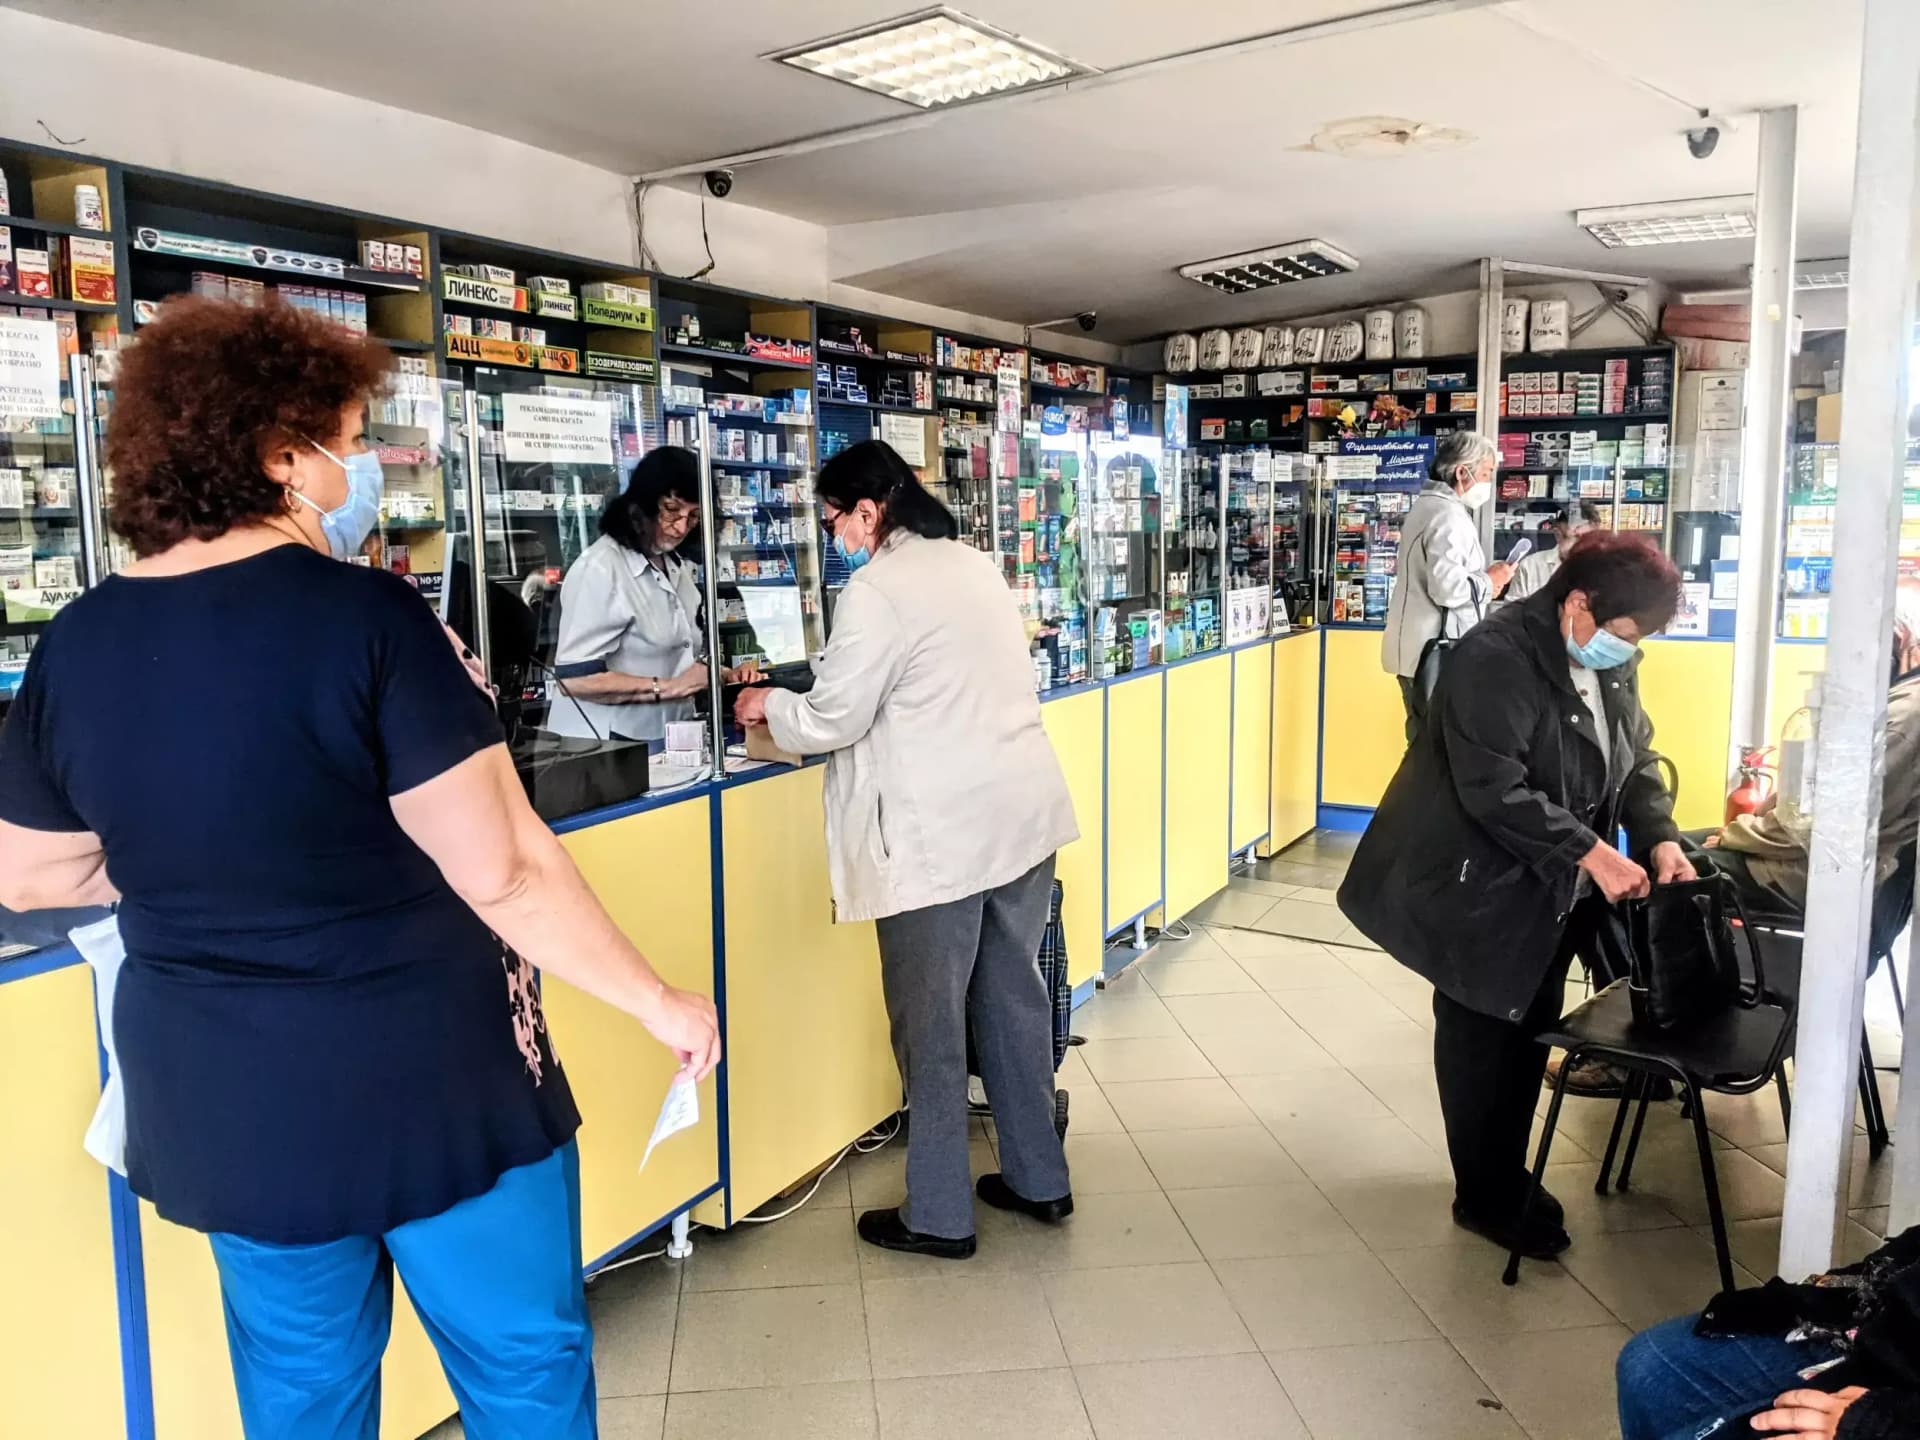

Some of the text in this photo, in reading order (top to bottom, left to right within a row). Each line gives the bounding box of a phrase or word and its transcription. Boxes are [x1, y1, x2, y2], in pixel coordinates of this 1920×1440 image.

[448, 280, 498, 303] ЛИНЕКС
[543, 299, 573, 313] ЛИНЕКС
[587, 303, 633, 322] Попедиум
[450, 337, 481, 358] АЦЦ
[542, 347, 559, 361] АЦЦ
[1048, 412, 1065, 423] URGO
[420, 575, 442, 585] NO-SP
